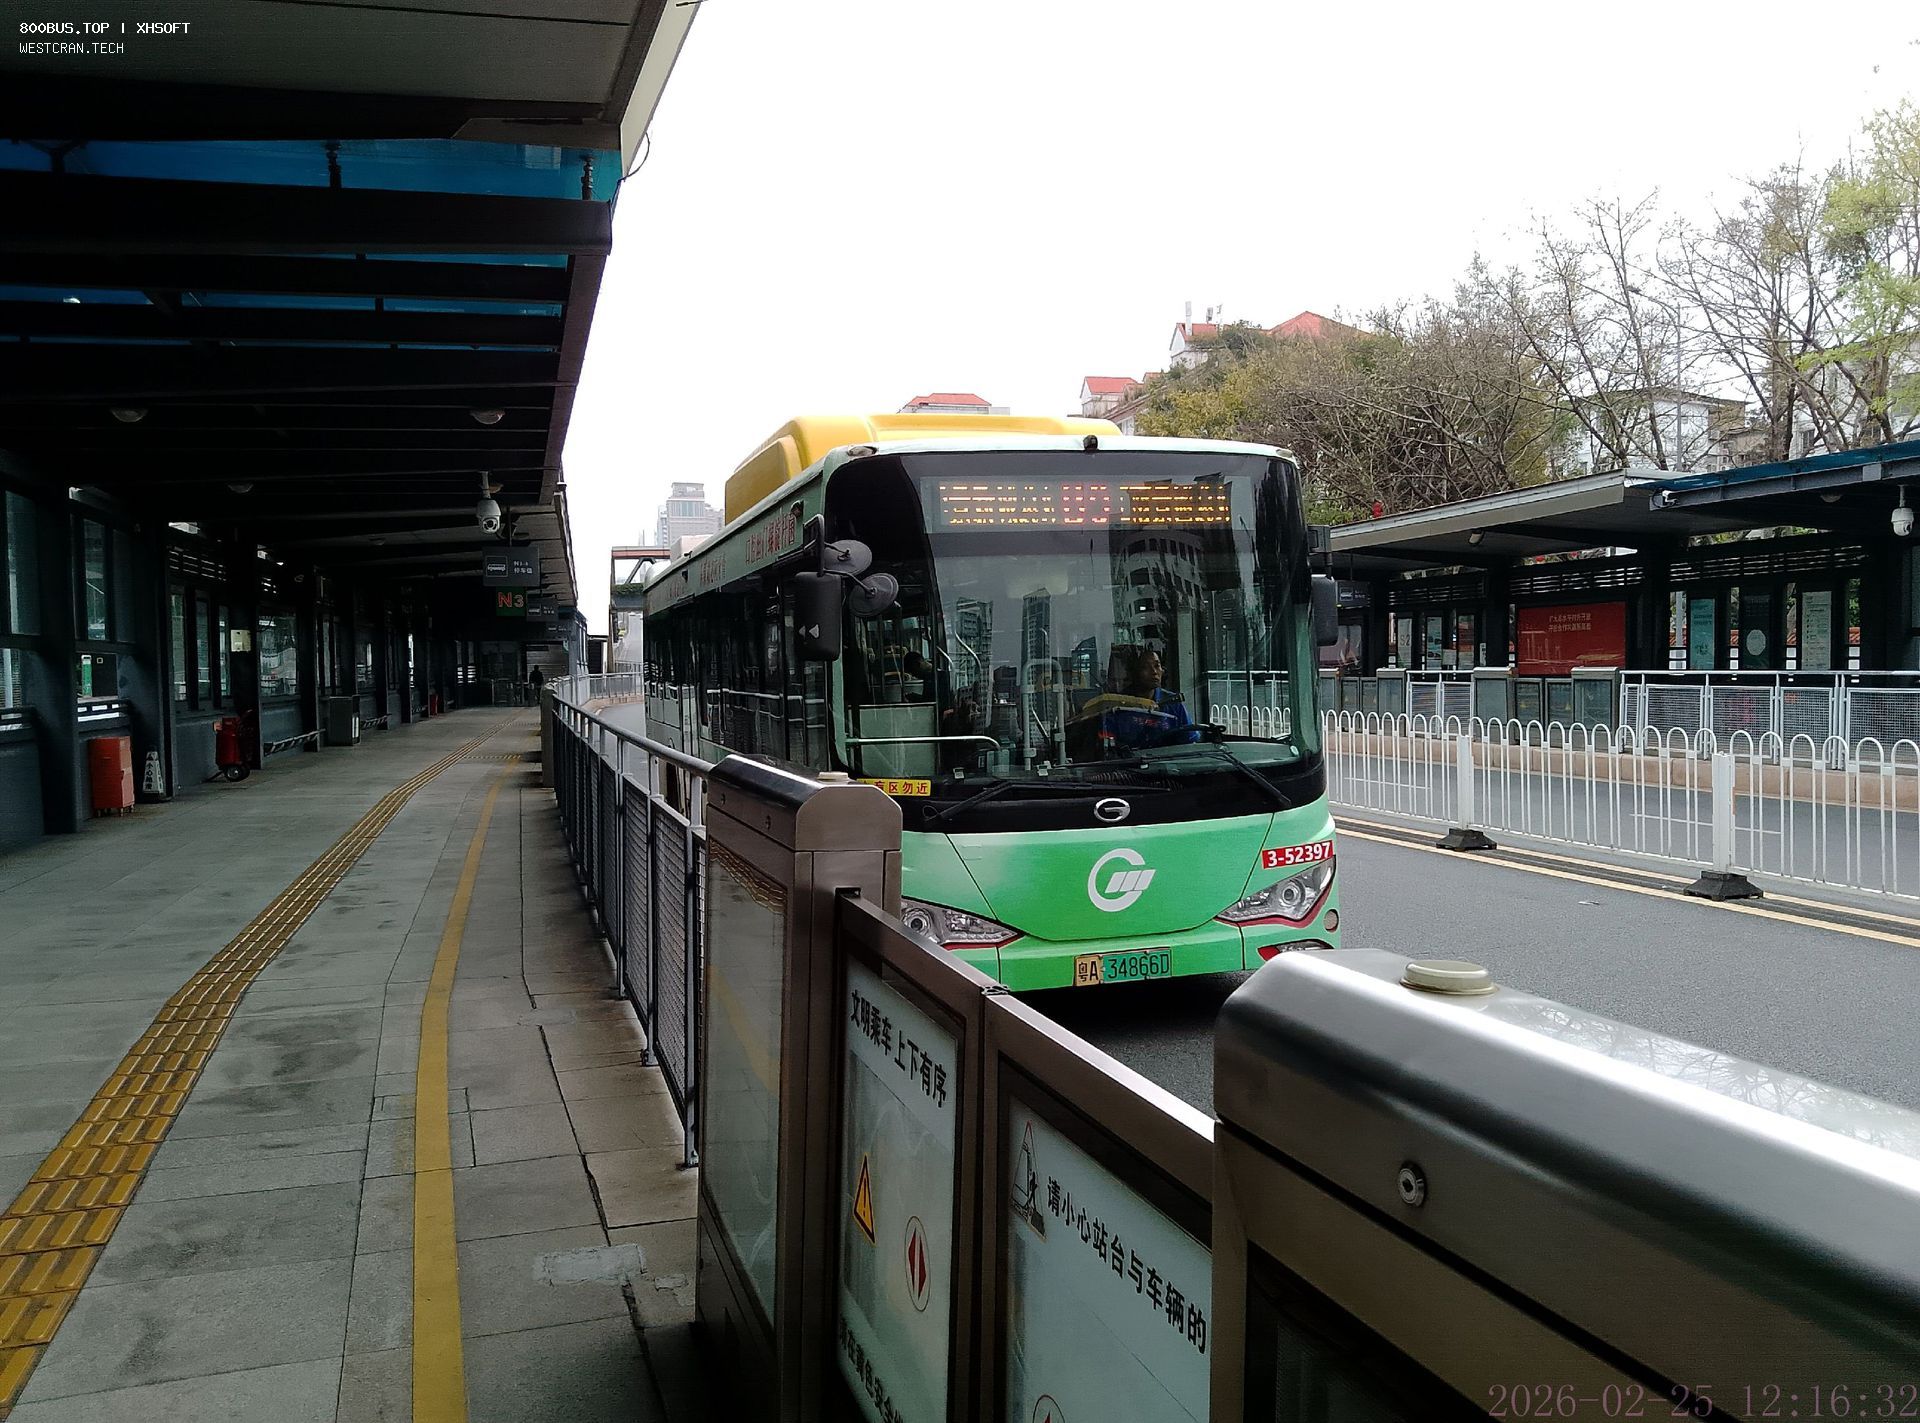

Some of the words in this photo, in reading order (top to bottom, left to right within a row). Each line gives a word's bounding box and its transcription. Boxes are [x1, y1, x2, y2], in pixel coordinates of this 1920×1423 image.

[497, 591, 524, 608] N3
[1267, 842, 1331, 867] 3-52397
[1047, 1175, 1207, 1355] 请小心站台与车辆的
